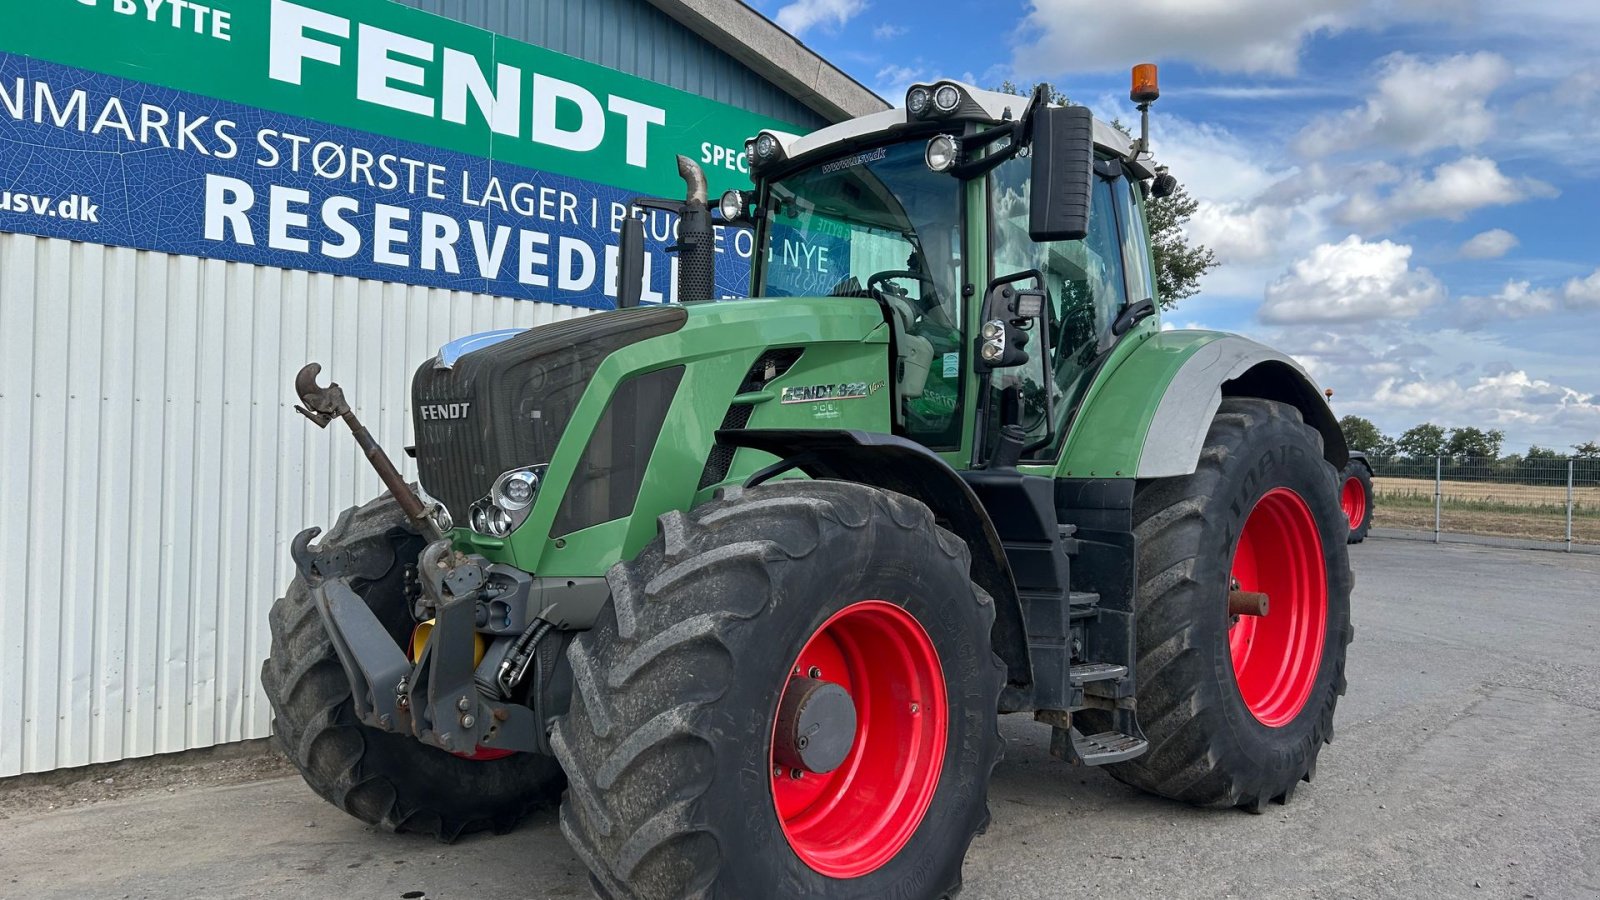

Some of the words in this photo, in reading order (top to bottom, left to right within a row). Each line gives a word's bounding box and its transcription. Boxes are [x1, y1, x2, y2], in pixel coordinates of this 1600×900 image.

[269, 0, 666, 168] FENDT
[701, 141, 750, 175] SPEC
[257, 128, 446, 200] STØRSTE
[462, 169, 577, 225] LAGER
[591, 199, 598, 229] I
[783, 238, 829, 274] NYE
[782, 384, 835, 402] FENDT
[838, 381, 867, 397] 822
[420, 402, 470, 420] FENDT
